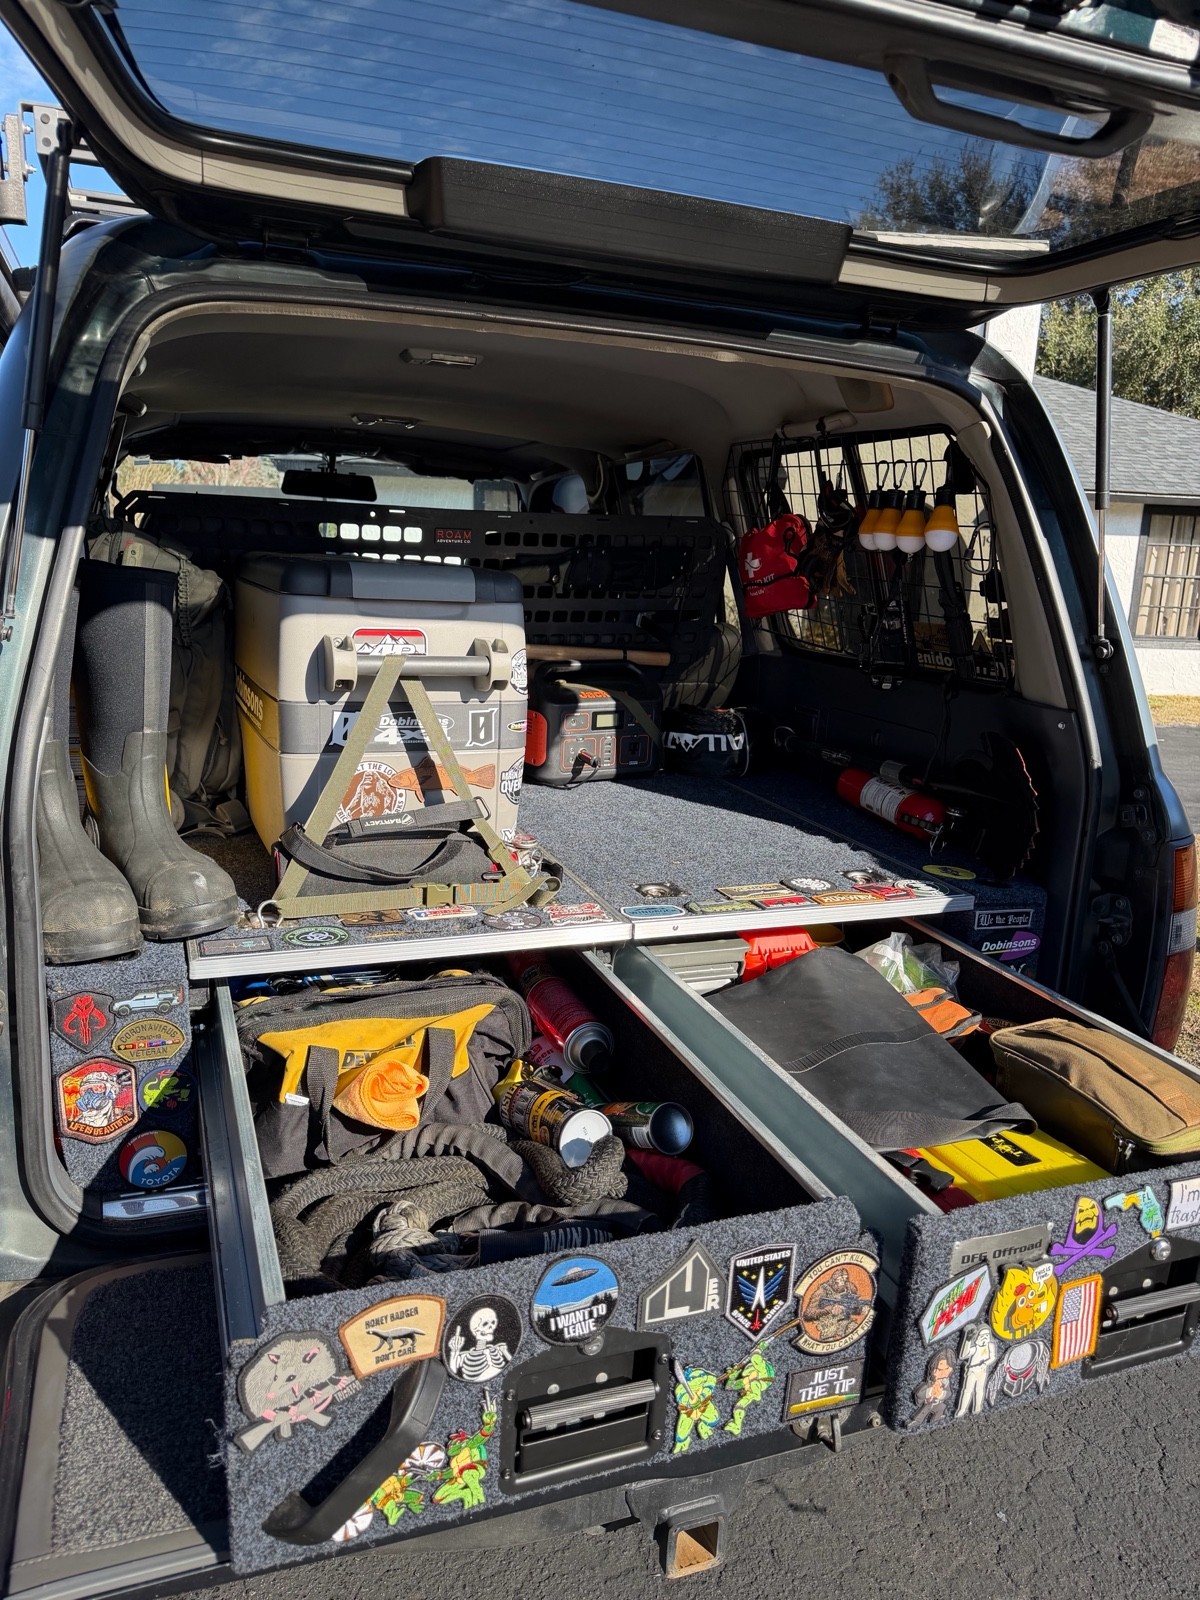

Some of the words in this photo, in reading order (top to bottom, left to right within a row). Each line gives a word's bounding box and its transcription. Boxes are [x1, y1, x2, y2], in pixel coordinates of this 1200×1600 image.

[437, 530, 472, 539] ROAM
[763, 573, 775, 584] KIT
[979, 914, 994, 926] We
[996, 915, 1006, 924] the
[1008, 914, 1029, 925] People
[981, 939, 1037, 952] Dobinsons
[120, 1022, 178, 1043] CORONAVIRUS
[130, 1047, 168, 1058] VETERAN
[69, 1122, 86, 1132] LIFE
[93, 1115, 132, 1136] BEAUTIFUL
[141, 1167, 180, 1186] TOYOTA
[1142, 1192, 1151, 1202] FL
[736, 1256, 764, 1267] UNITED
[764, 1250, 791, 1262] STATES
[961, 1251, 988, 1264] DFG
[992, 1239, 1043, 1259] Offroad
[808, 1266, 823, 1280] YOU
[824, 1254, 848, 1268] CAN'T
[849, 1253, 864, 1264] KILL
[365, 1315, 389, 1329] HONEY
[390, 1306, 419, 1321] BADGER
[550, 1318, 556, 1331] I
[556, 1308, 591, 1329] WANT
[590, 1304, 607, 1318] TO
[731, 1309, 752, 1329] SPACE
[763, 1300, 785, 1323] FORCE
[564, 1319, 597, 1339] LEAVE
[801, 1339, 819, 1351] WHAT
[821, 1342, 837, 1352] YOU
[838, 1330, 860, 1349] CAN'T
[397, 1346, 417, 1358] CARE
[809, 1366, 849, 1386] JUST
[800, 1384, 829, 1402] THE
[833, 1378, 856, 1394] TIP
